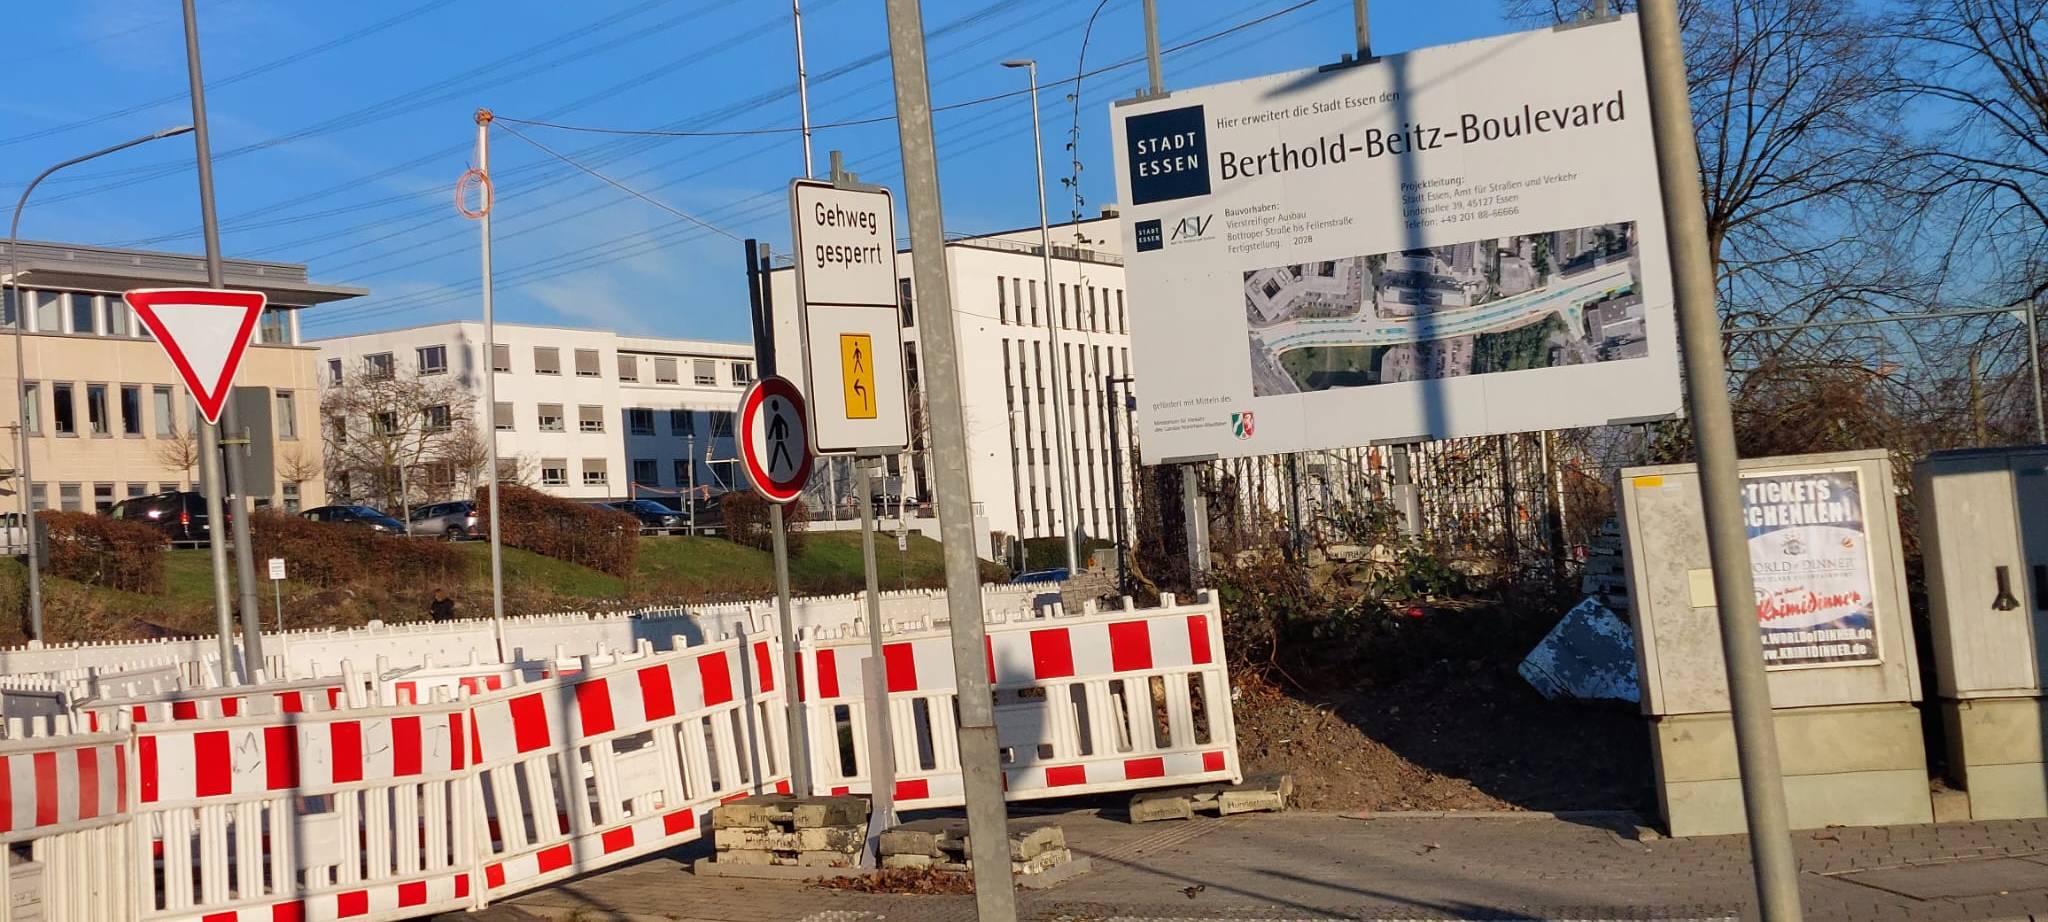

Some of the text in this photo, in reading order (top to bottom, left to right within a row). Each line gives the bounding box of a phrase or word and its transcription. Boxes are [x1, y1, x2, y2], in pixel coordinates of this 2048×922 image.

[1216, 90, 1400, 130] Hier erweitert die Stadt Essen den
[1137, 131, 1197, 155] STADT
[1219, 89, 1626, 181] Berthold-Beitz-Boulevard
[1139, 154, 1199, 177] ESSEN
[1400, 176, 1466, 192] Projektleitung:
[1402, 194, 1425, 205] Stadt
[1454, 188, 1472, 197] Amt
[1474, 185, 1487, 195] für
[1489, 181, 1523, 193] Straßen
[1524, 178, 1542, 188] und
[1543, 172, 1578, 184] Verkehr
[1224, 203, 1281, 217] Bauvorhaben:
[1466, 198, 1494, 208] 45127
[1496, 194, 1519, 204] Essen
[815, 201, 877, 235] Gehweg
[1278, 211, 1307, 223] Ausbau
[1459, 212, 1475, 222] 201
[1227, 227, 1264, 242] Bottroper
[1265, 224, 1292, 236] Straße
[1293, 221, 1305, 232] bis
[815, 242, 882, 269] gesperrt
[1228, 238, 1281, 254] Fertigstellung
[1293, 235, 1313, 245] 2028
[1746, 479, 1832, 504] TICKETS
[1751, 560, 1792, 573] ORLD
[1802, 557, 1855, 571] DINNER
